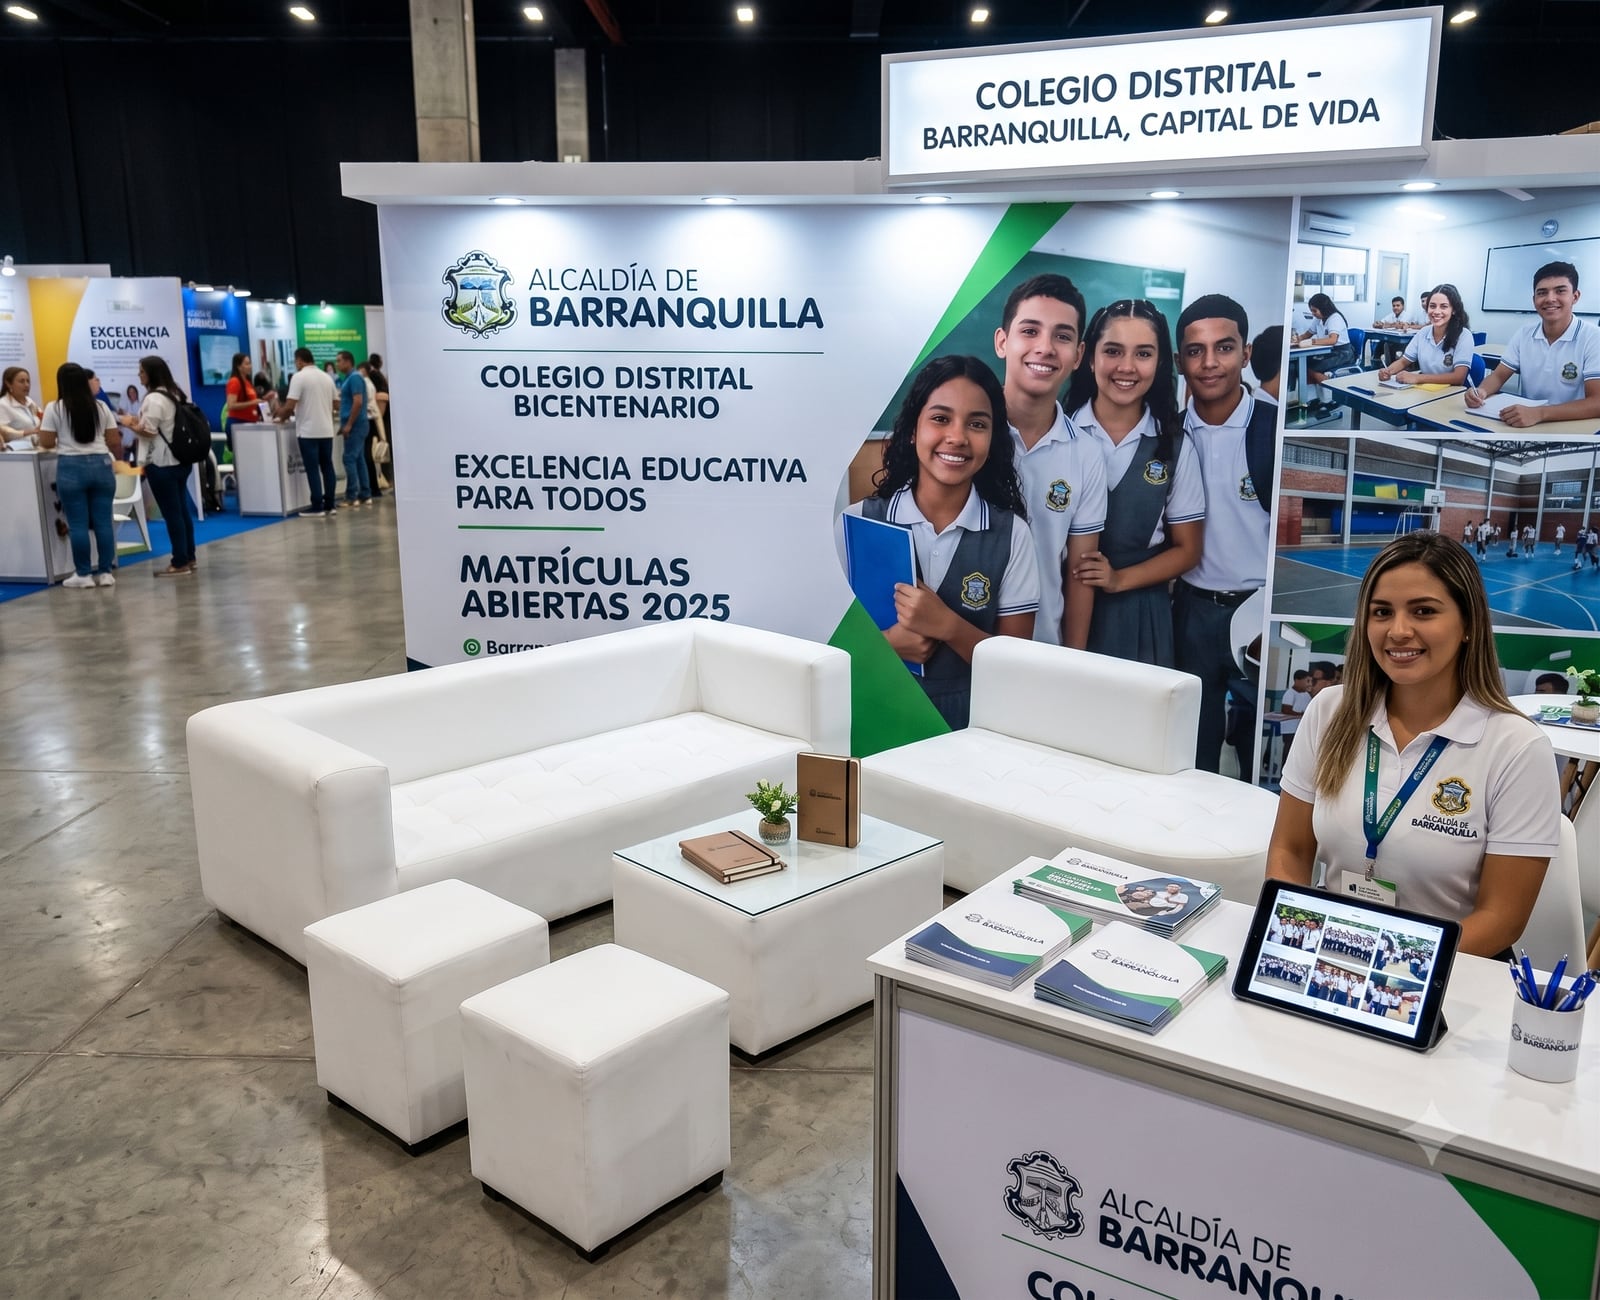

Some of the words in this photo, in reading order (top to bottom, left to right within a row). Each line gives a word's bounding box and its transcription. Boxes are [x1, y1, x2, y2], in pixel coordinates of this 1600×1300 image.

[976, 74, 1117, 110] COLEGIO
[1130, 60, 1295, 100] DISTRITAL
[923, 115, 1131, 150] BARRANQUILLA,
[1140, 108, 1252, 137] CAPITAL
[1263, 103, 1298, 128] DE
[1309, 98, 1380, 125] VIDA
[529, 262, 656, 291] ALCALDÍA
[667, 269, 698, 291] DE
[529, 297, 825, 329] BARRANQUILLA
[89, 326, 170, 338] EXCELENCIA
[91, 339, 158, 350] EDUCATIVA
[480, 365, 605, 389] COLEGIO
[616, 366, 753, 390] DISTRITAL
[514, 395, 720, 419] BICENTENARIO
[455, 455, 630, 481] EXCELENCIA
[642, 457, 807, 483] EDUCATIVA
[457, 486, 534, 510] PARA
[542, 487, 647, 512] TODOS
[460, 547, 690, 586] MATRÍCULAS
[461, 590, 630, 620] ABIERTAS
[642, 592, 731, 622] 2025
[1411, 818, 1478, 838] BARRANQUILLA
[1422, 814, 1458, 828] ALCALDÍA
[1460, 821, 1469, 829] DE
[1100, 1188, 1241, 1256] ALCALDÍA
[1252, 1238, 1291, 1272] DE
